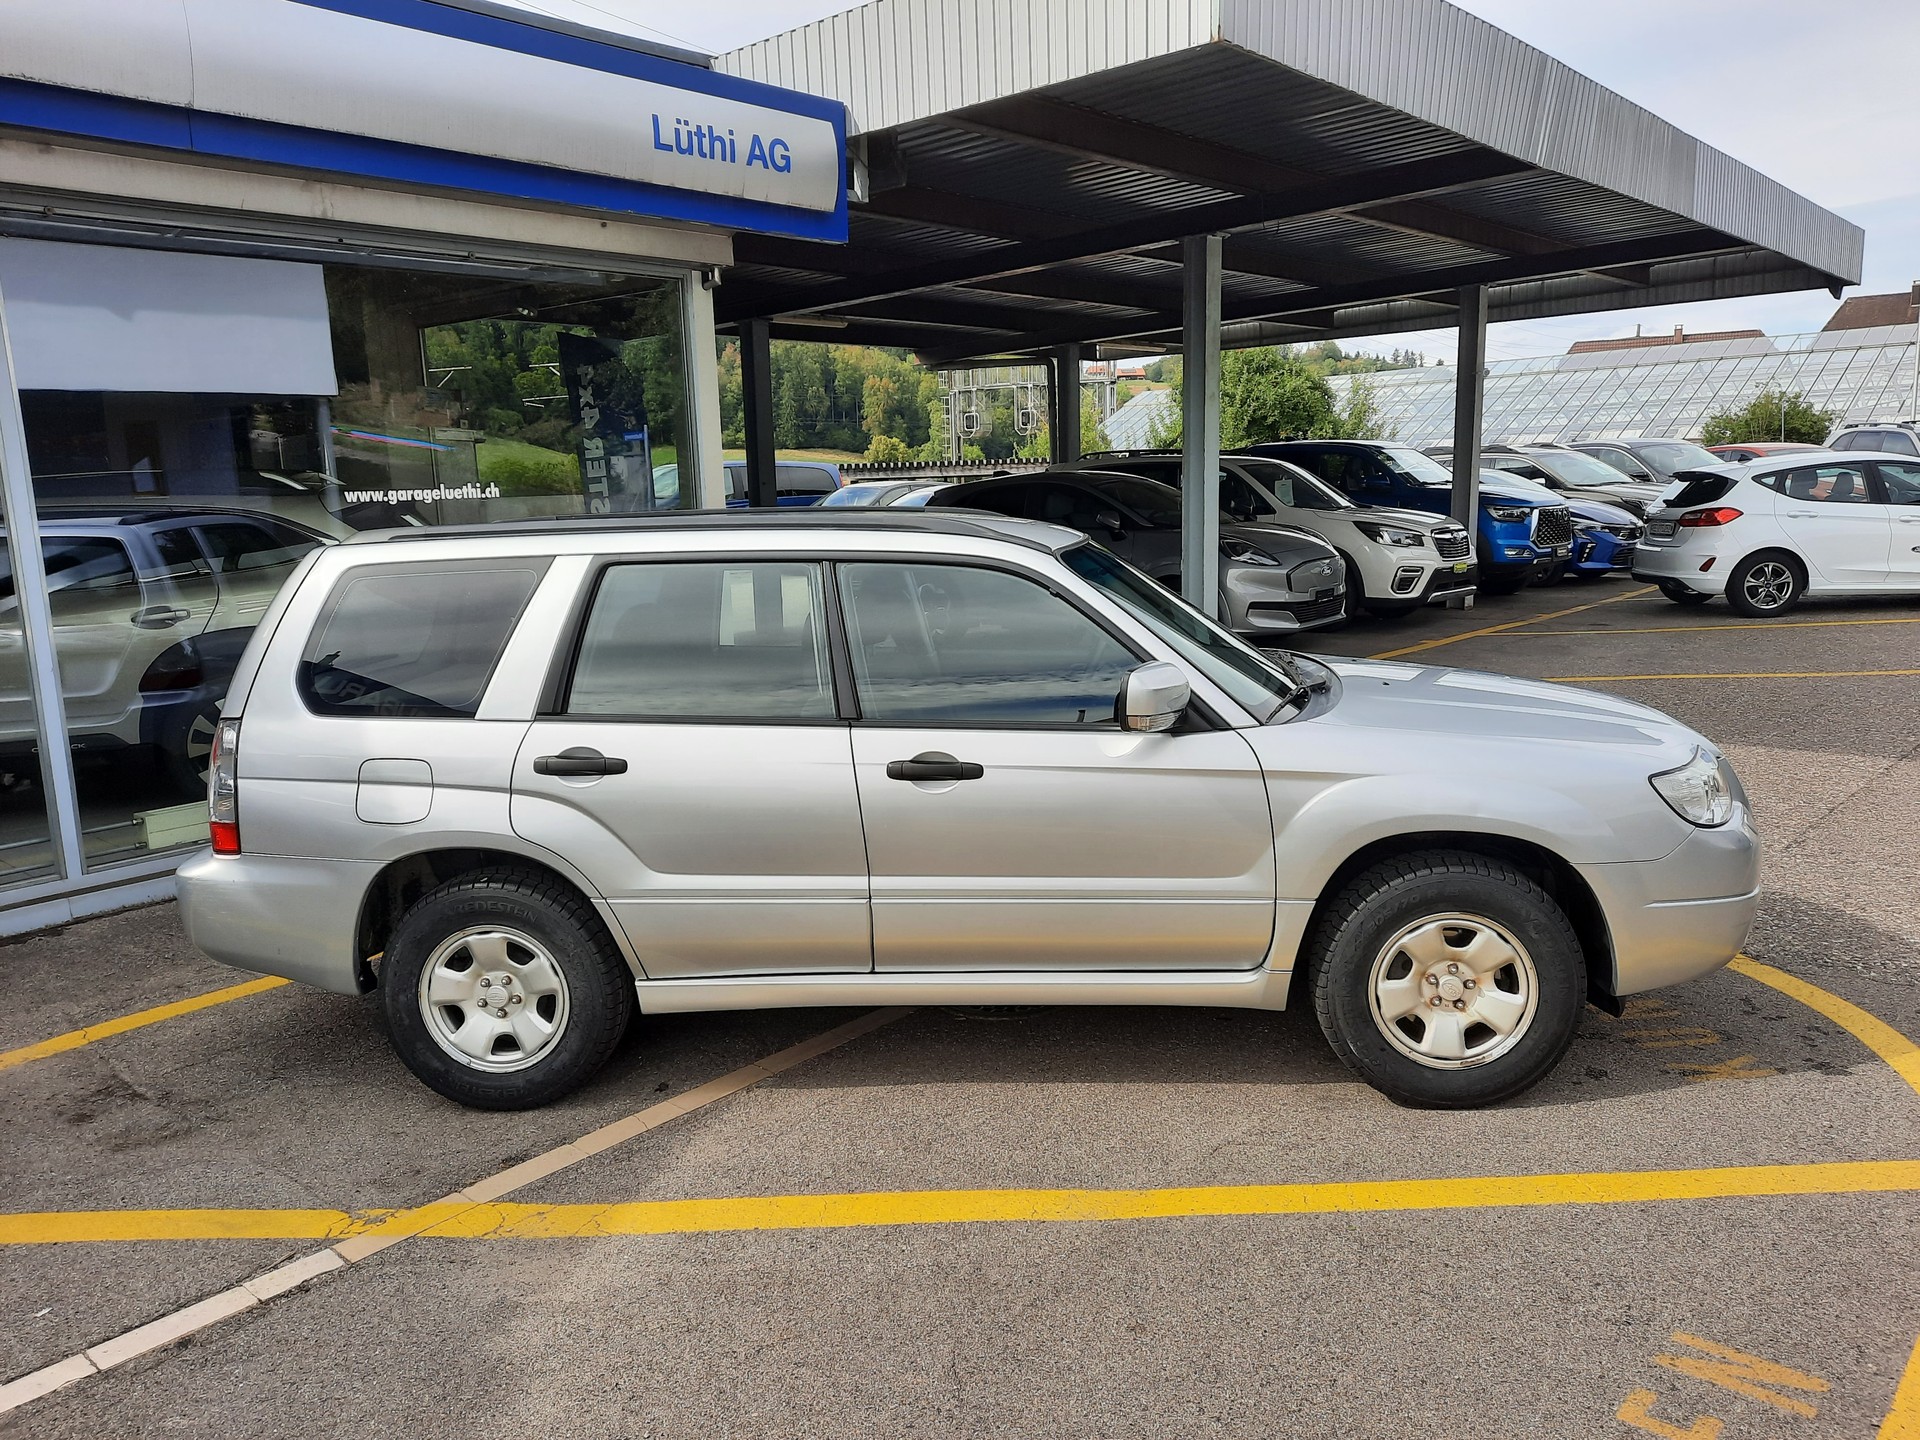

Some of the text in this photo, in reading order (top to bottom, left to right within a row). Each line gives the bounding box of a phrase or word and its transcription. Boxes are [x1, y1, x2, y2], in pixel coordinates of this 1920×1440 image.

[652, 113, 792, 173] Lüthi AG
[344, 482, 500, 505] www.garageluethi.ch
